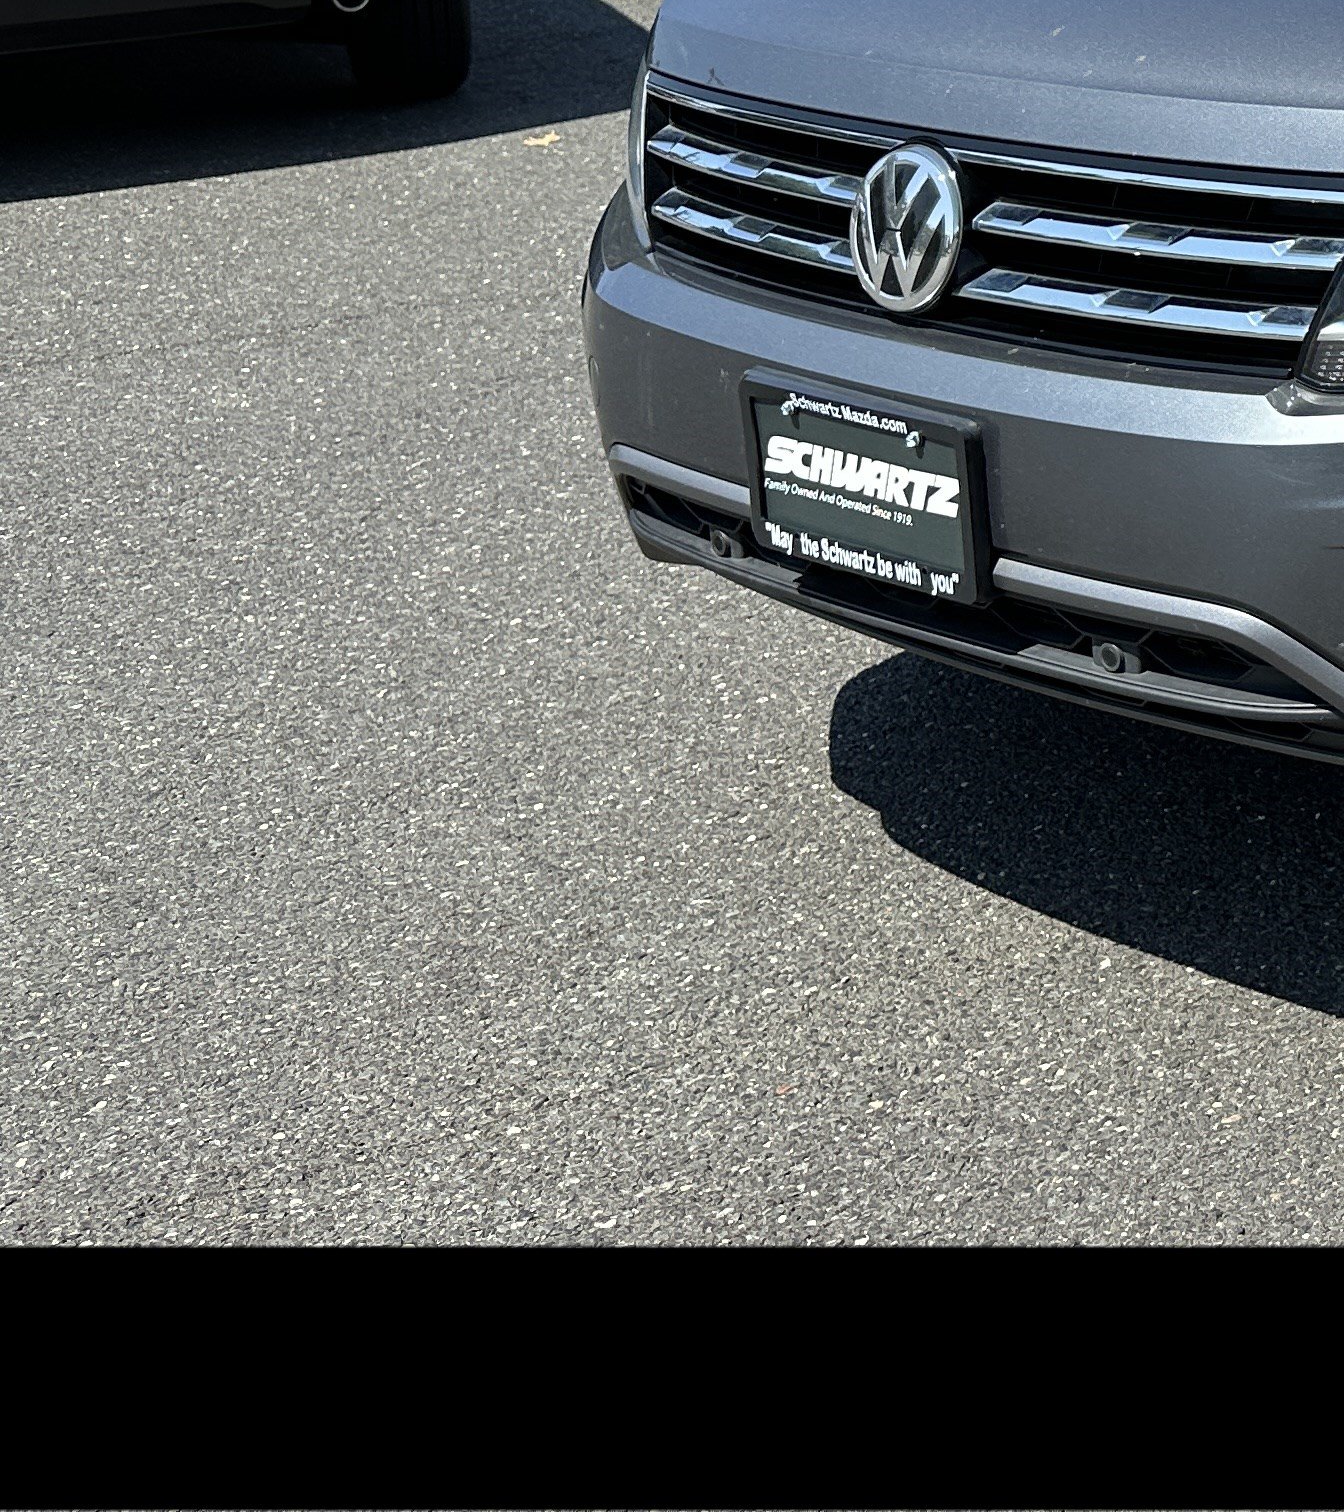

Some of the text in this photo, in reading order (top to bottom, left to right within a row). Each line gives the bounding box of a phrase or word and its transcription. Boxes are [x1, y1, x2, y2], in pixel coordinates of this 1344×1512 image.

[764, 435, 960, 519] SCHWARTZ
[764, 478, 791, 495] Family
[791, 484, 819, 501] Owned
[819, 489, 836, 505] And
[836, 494, 872, 515] Operated
[872, 503, 892, 521] Since
[765, 522, 960, 596] "May the Schwartz be with you"
